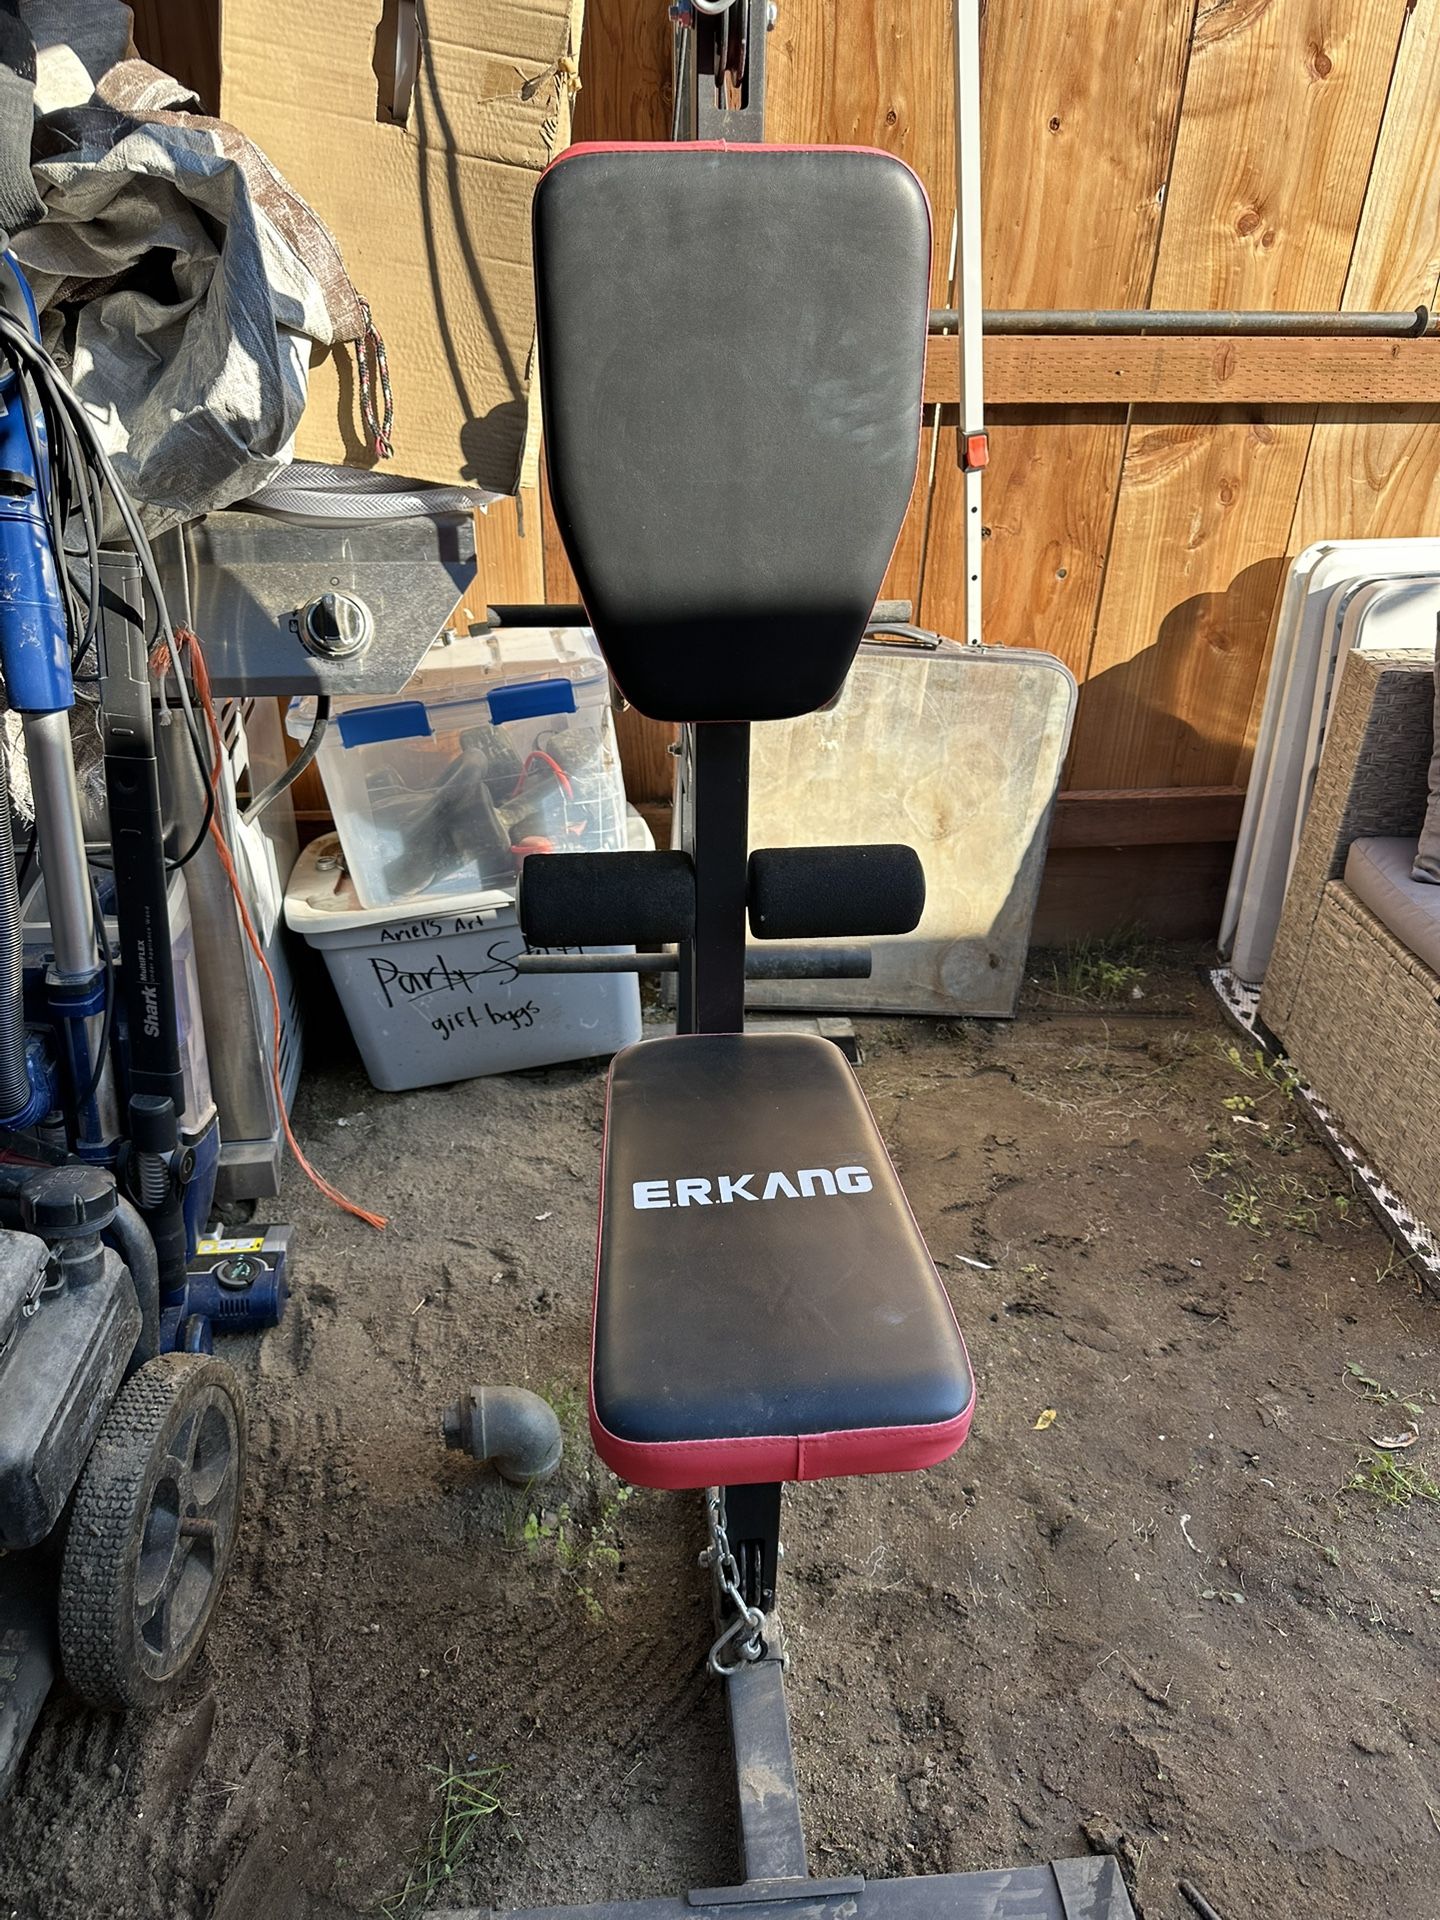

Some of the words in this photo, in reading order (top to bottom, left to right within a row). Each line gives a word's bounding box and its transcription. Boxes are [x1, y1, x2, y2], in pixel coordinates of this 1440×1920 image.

[455, 915, 485, 934] Art
[142, 986, 160, 1038] Shark
[431, 1006, 480, 1041] gift
